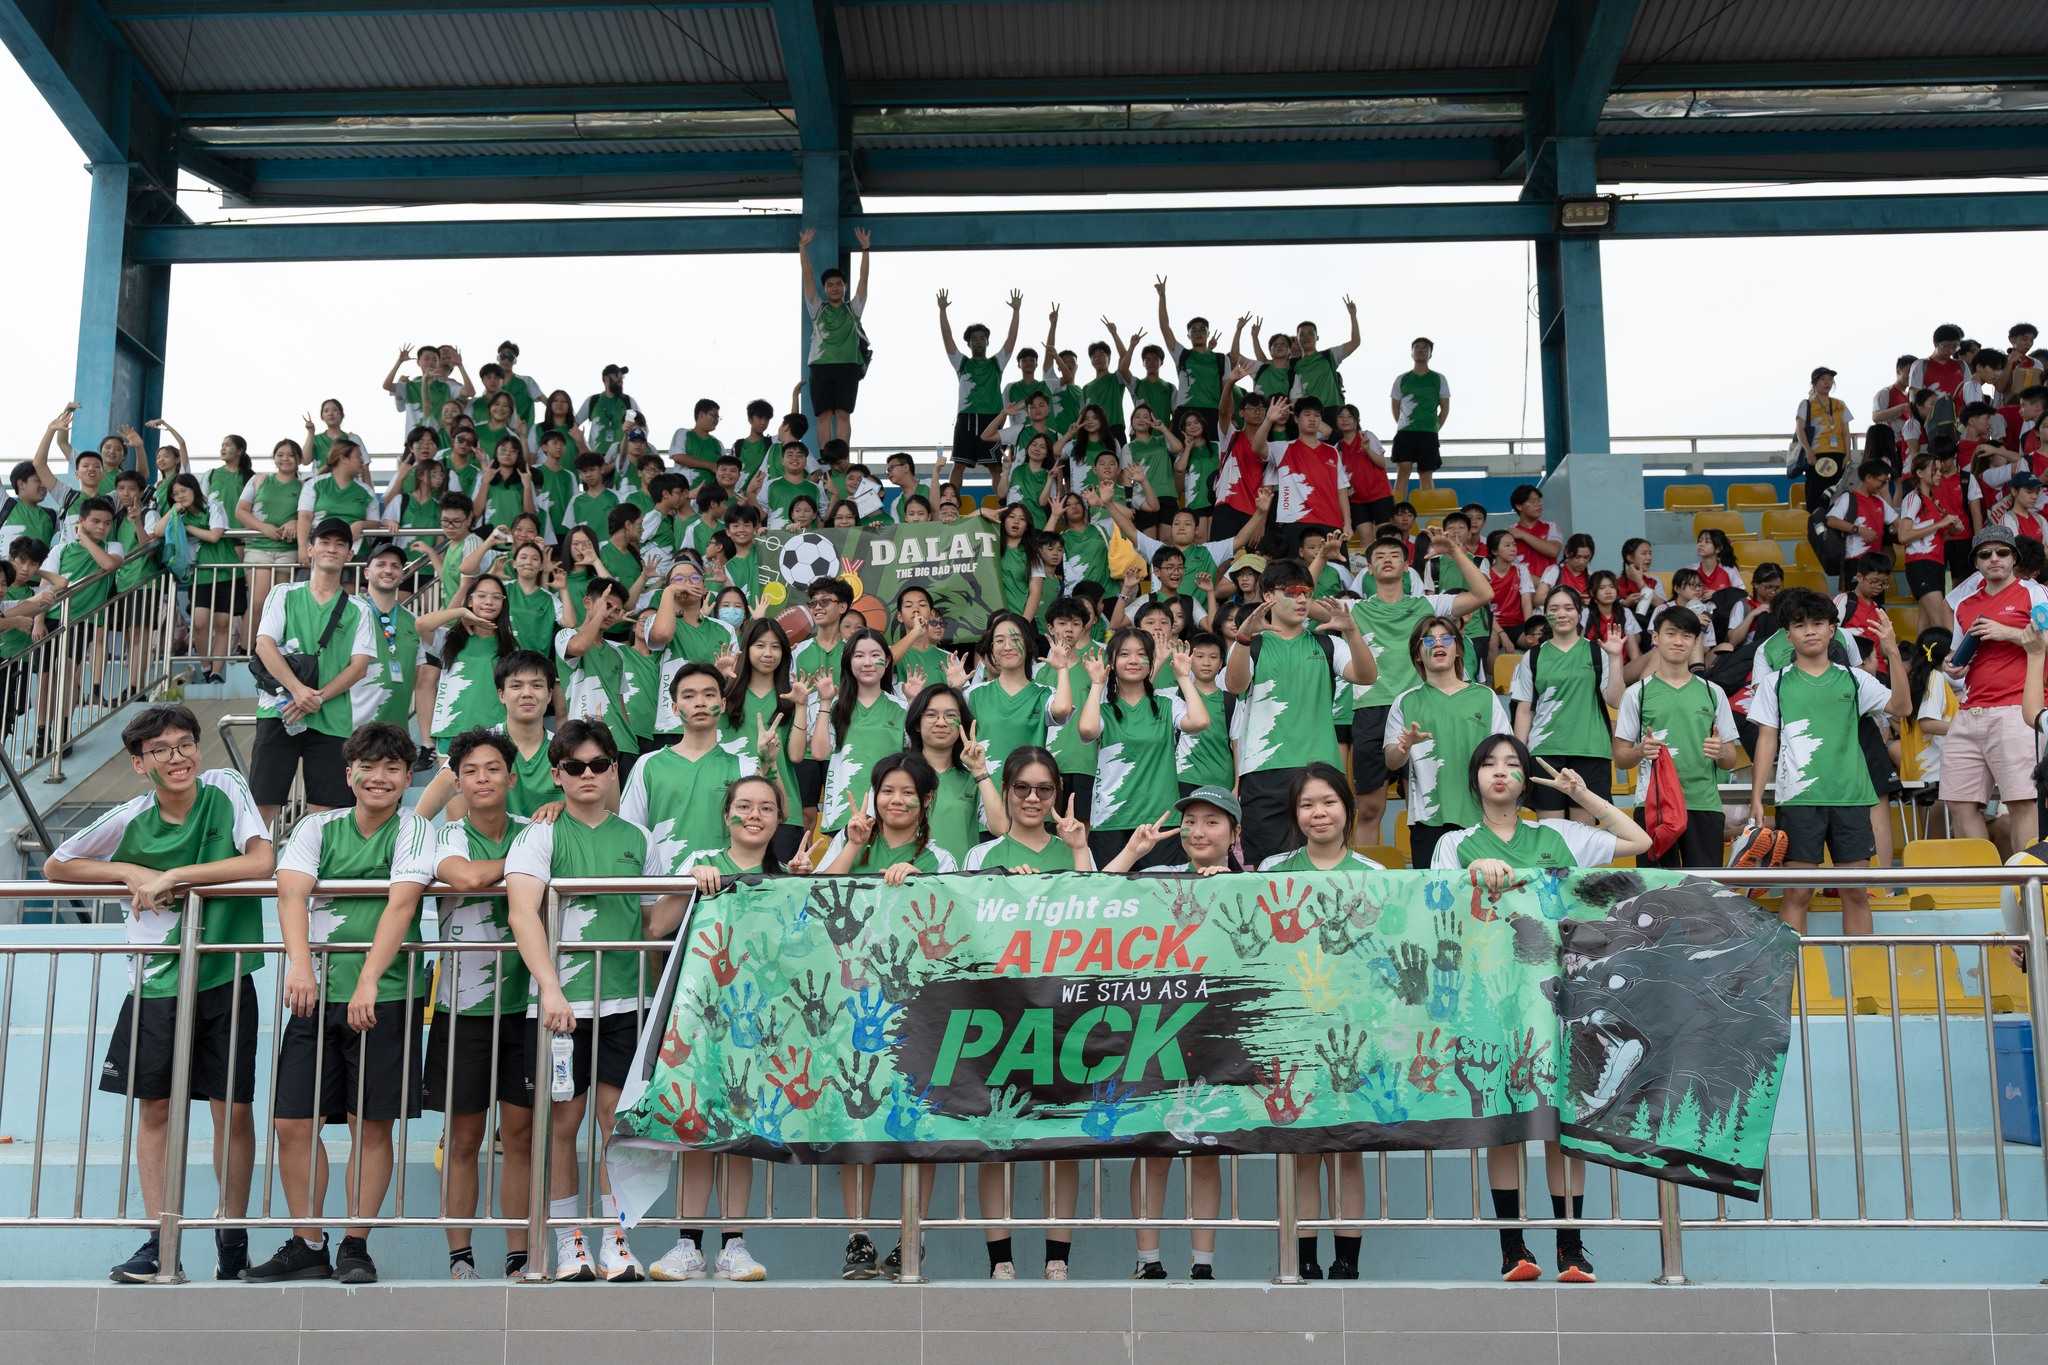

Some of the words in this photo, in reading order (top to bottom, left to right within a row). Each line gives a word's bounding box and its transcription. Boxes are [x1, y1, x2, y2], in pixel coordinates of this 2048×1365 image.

[1282, 486, 1290, 510] HANOI
[870, 532, 997, 566] DALAT
[895, 568, 913, 579] THE
[914, 566, 930, 577] BIG
[931, 565, 950, 576] BAD
[952, 562, 978, 574] WOLF
[435, 682, 448, 715] DALAT
[661, 673, 670, 709] DALAT
[825, 770, 835, 807] DALAT
[1094, 768, 1103, 804] DALAT
[976, 898, 1020, 923] We
[1024, 894, 1100, 927] fight
[1103, 897, 1140, 919] as
[992, 929, 1032, 974] A
[1042, 924, 1209, 973] PACK,
[1062, 983, 1090, 1004] WE
[1097, 980, 1151, 1002] STAY
[1158, 979, 1188, 1000] AS
[1195, 978, 1209, 999] A
[930, 1001, 1209, 1087] PACK
